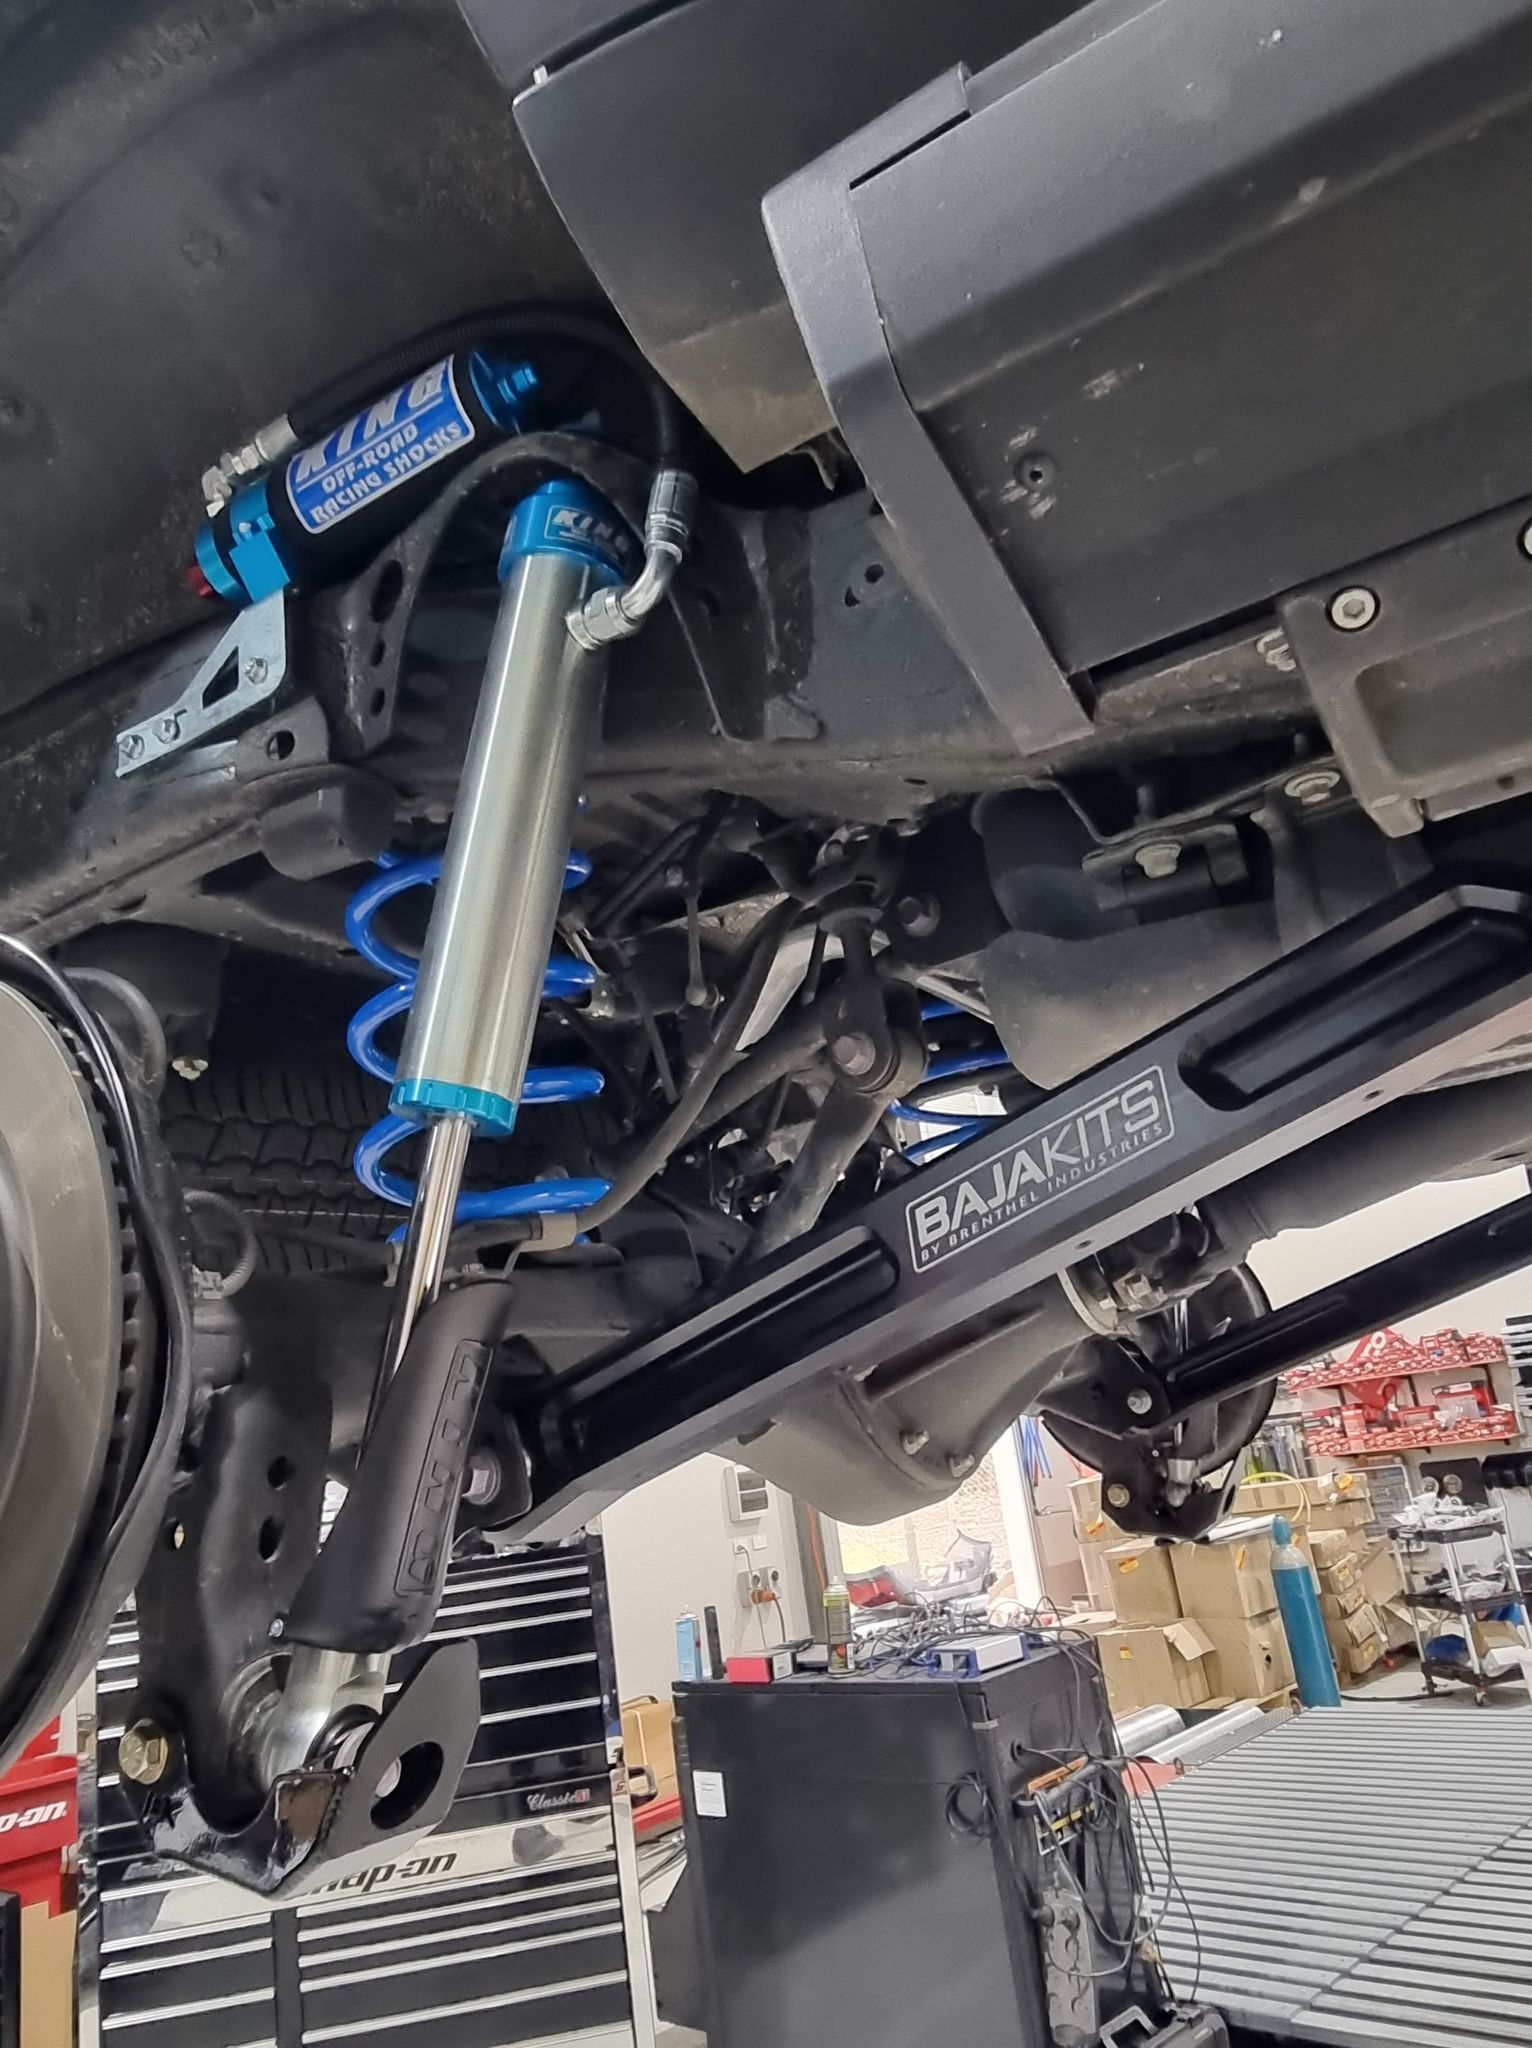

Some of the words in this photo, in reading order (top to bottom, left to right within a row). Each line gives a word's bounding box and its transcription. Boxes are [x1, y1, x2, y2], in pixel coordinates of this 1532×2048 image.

[310, 471, 383, 525] RACING
[383, 421, 462, 479] SHOCKS
[321, 422, 418, 494] OFF-ROAD
[914, 1079, 1160, 1247] BAJAKITS
[920, 1244, 941, 1263] BY
[949, 1191, 1039, 1245] BRENTHEL
[1047, 1123, 1163, 1193] INDUSTRIES
